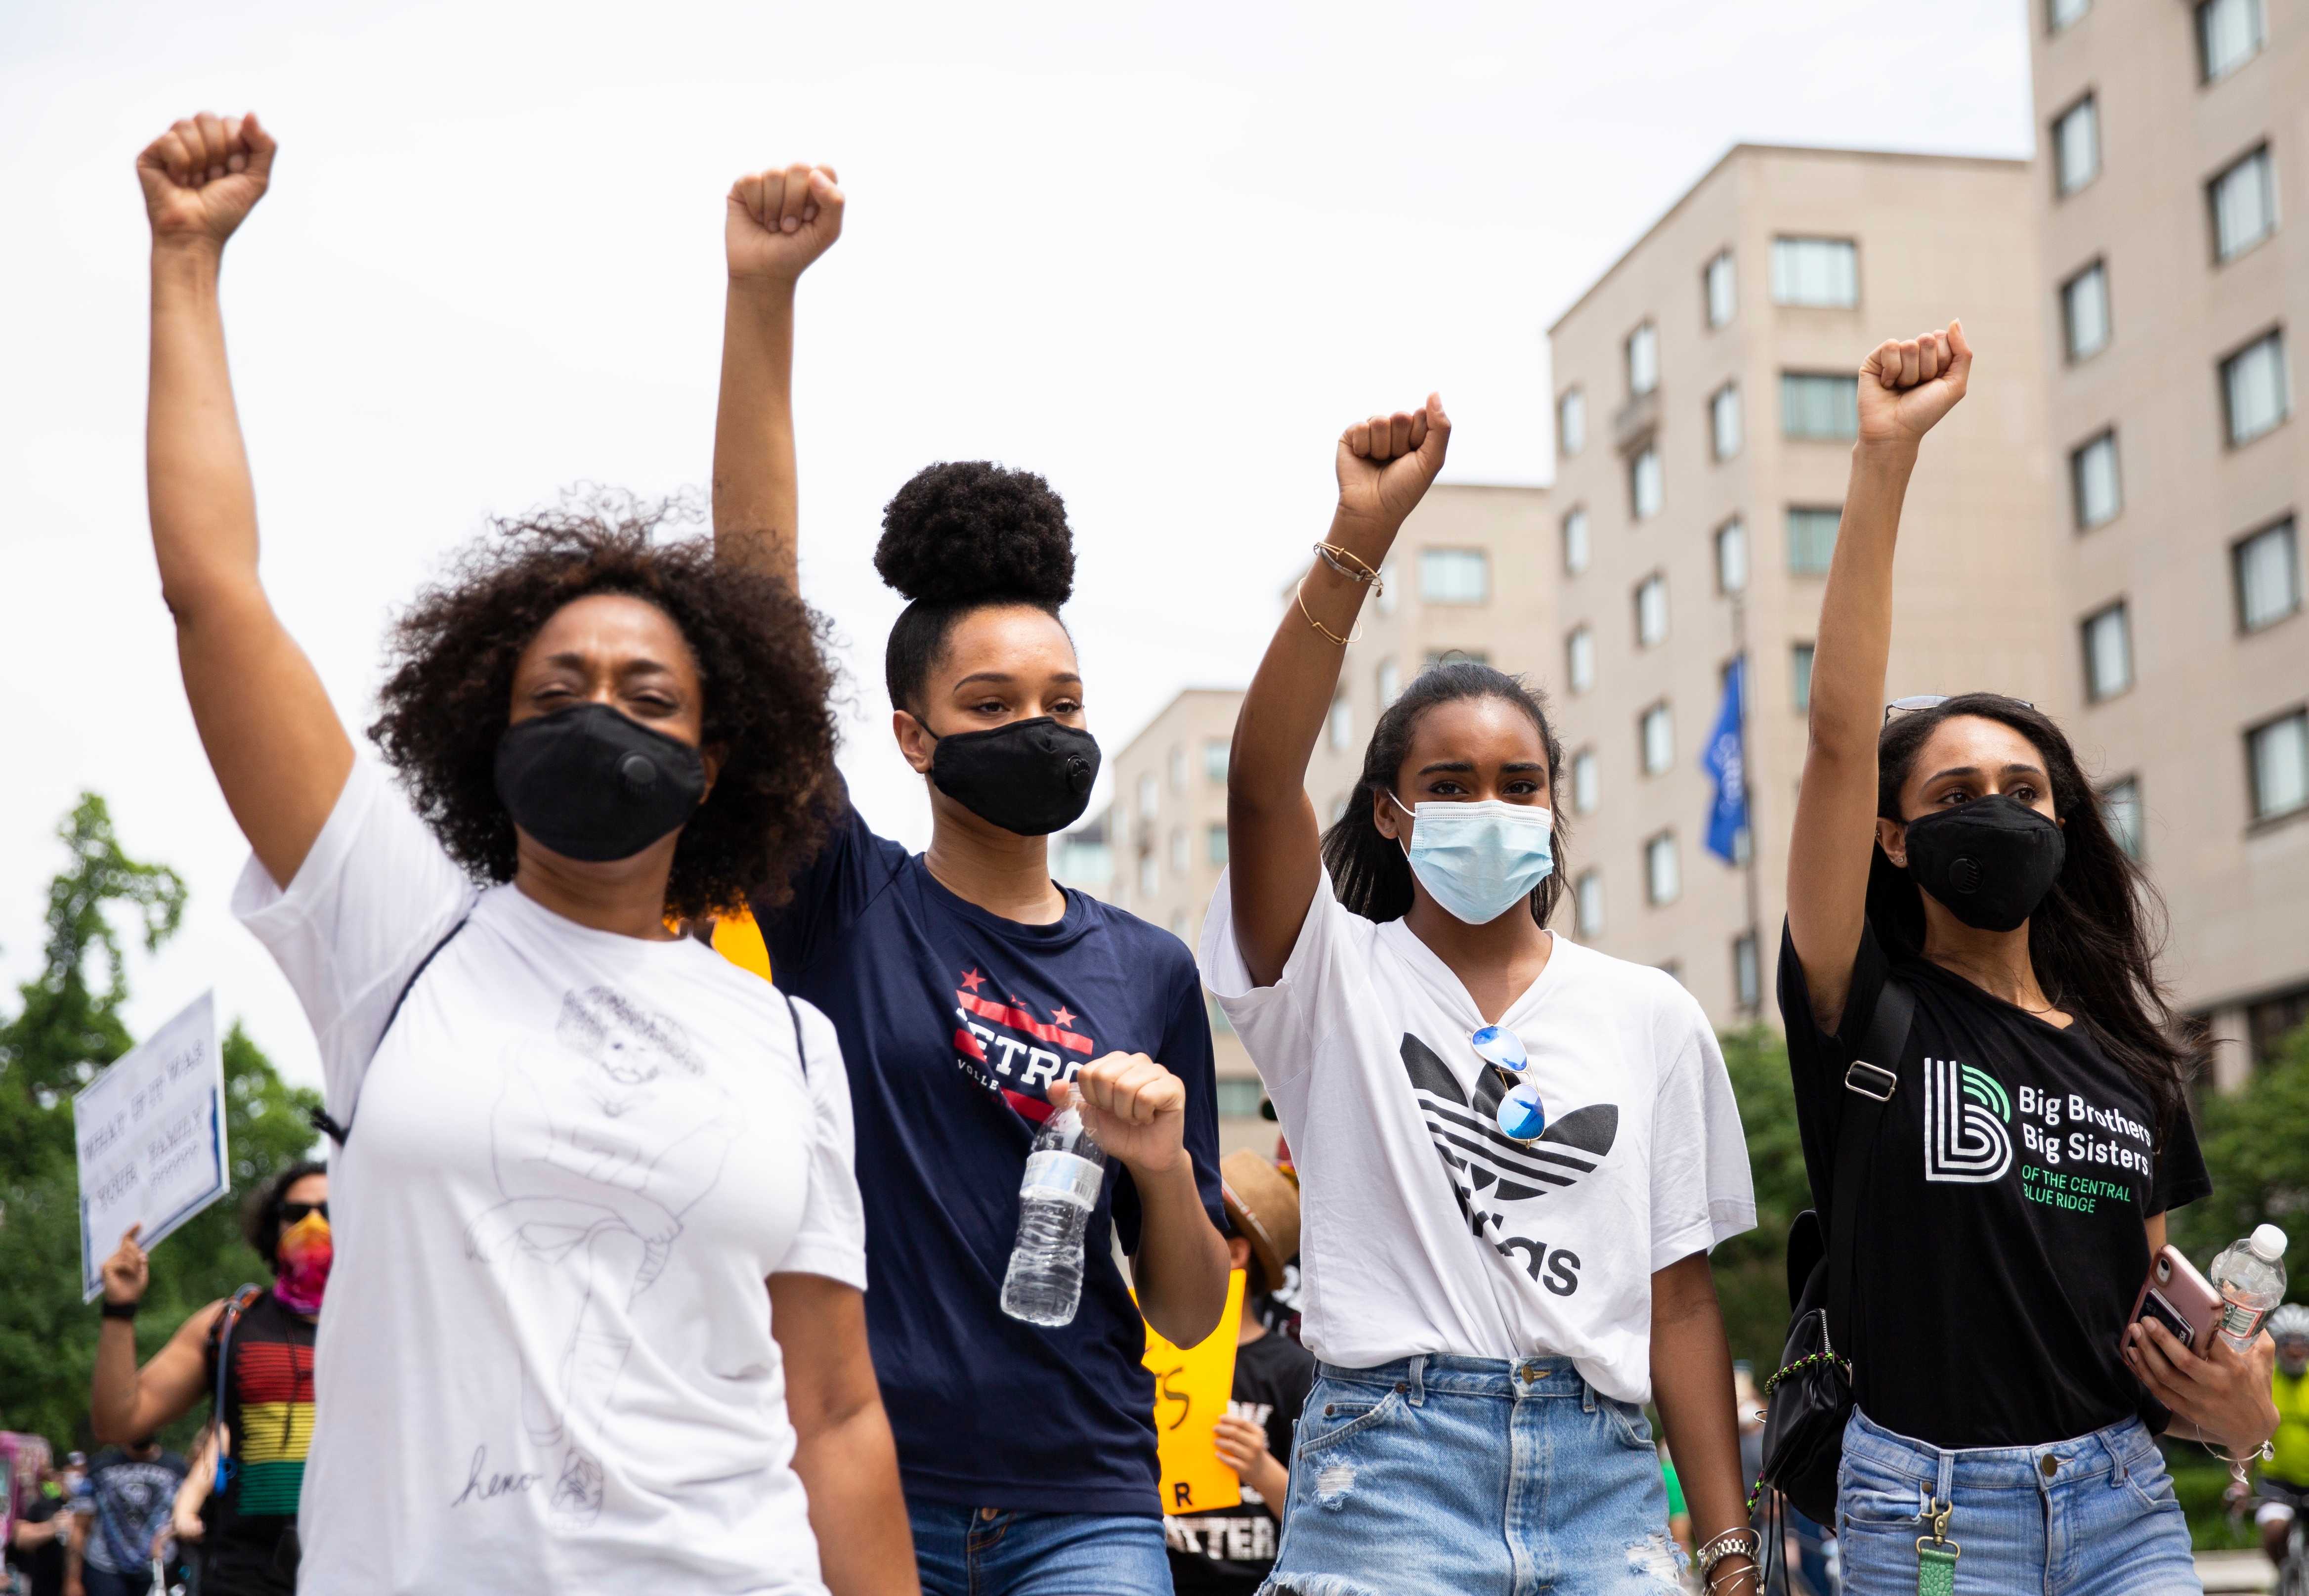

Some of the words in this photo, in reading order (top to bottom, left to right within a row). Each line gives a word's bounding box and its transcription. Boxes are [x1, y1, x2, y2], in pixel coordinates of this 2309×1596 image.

[2019, 1085, 2061, 1125] Big
[2069, 1094, 2150, 1147] Brothers
[2022, 1122, 2060, 1164] Big
[2068, 1132, 2148, 1175] Sisters
[2022, 1165, 2040, 1181] OF
[2043, 1169, 2067, 1189] THE
[2070, 1176, 2131, 1202] CENTRAL
[2023, 1182, 2053, 1205] BLUE
[2056, 1192, 2096, 1213] RIDGE
[451, 1444, 543, 1508] hero
